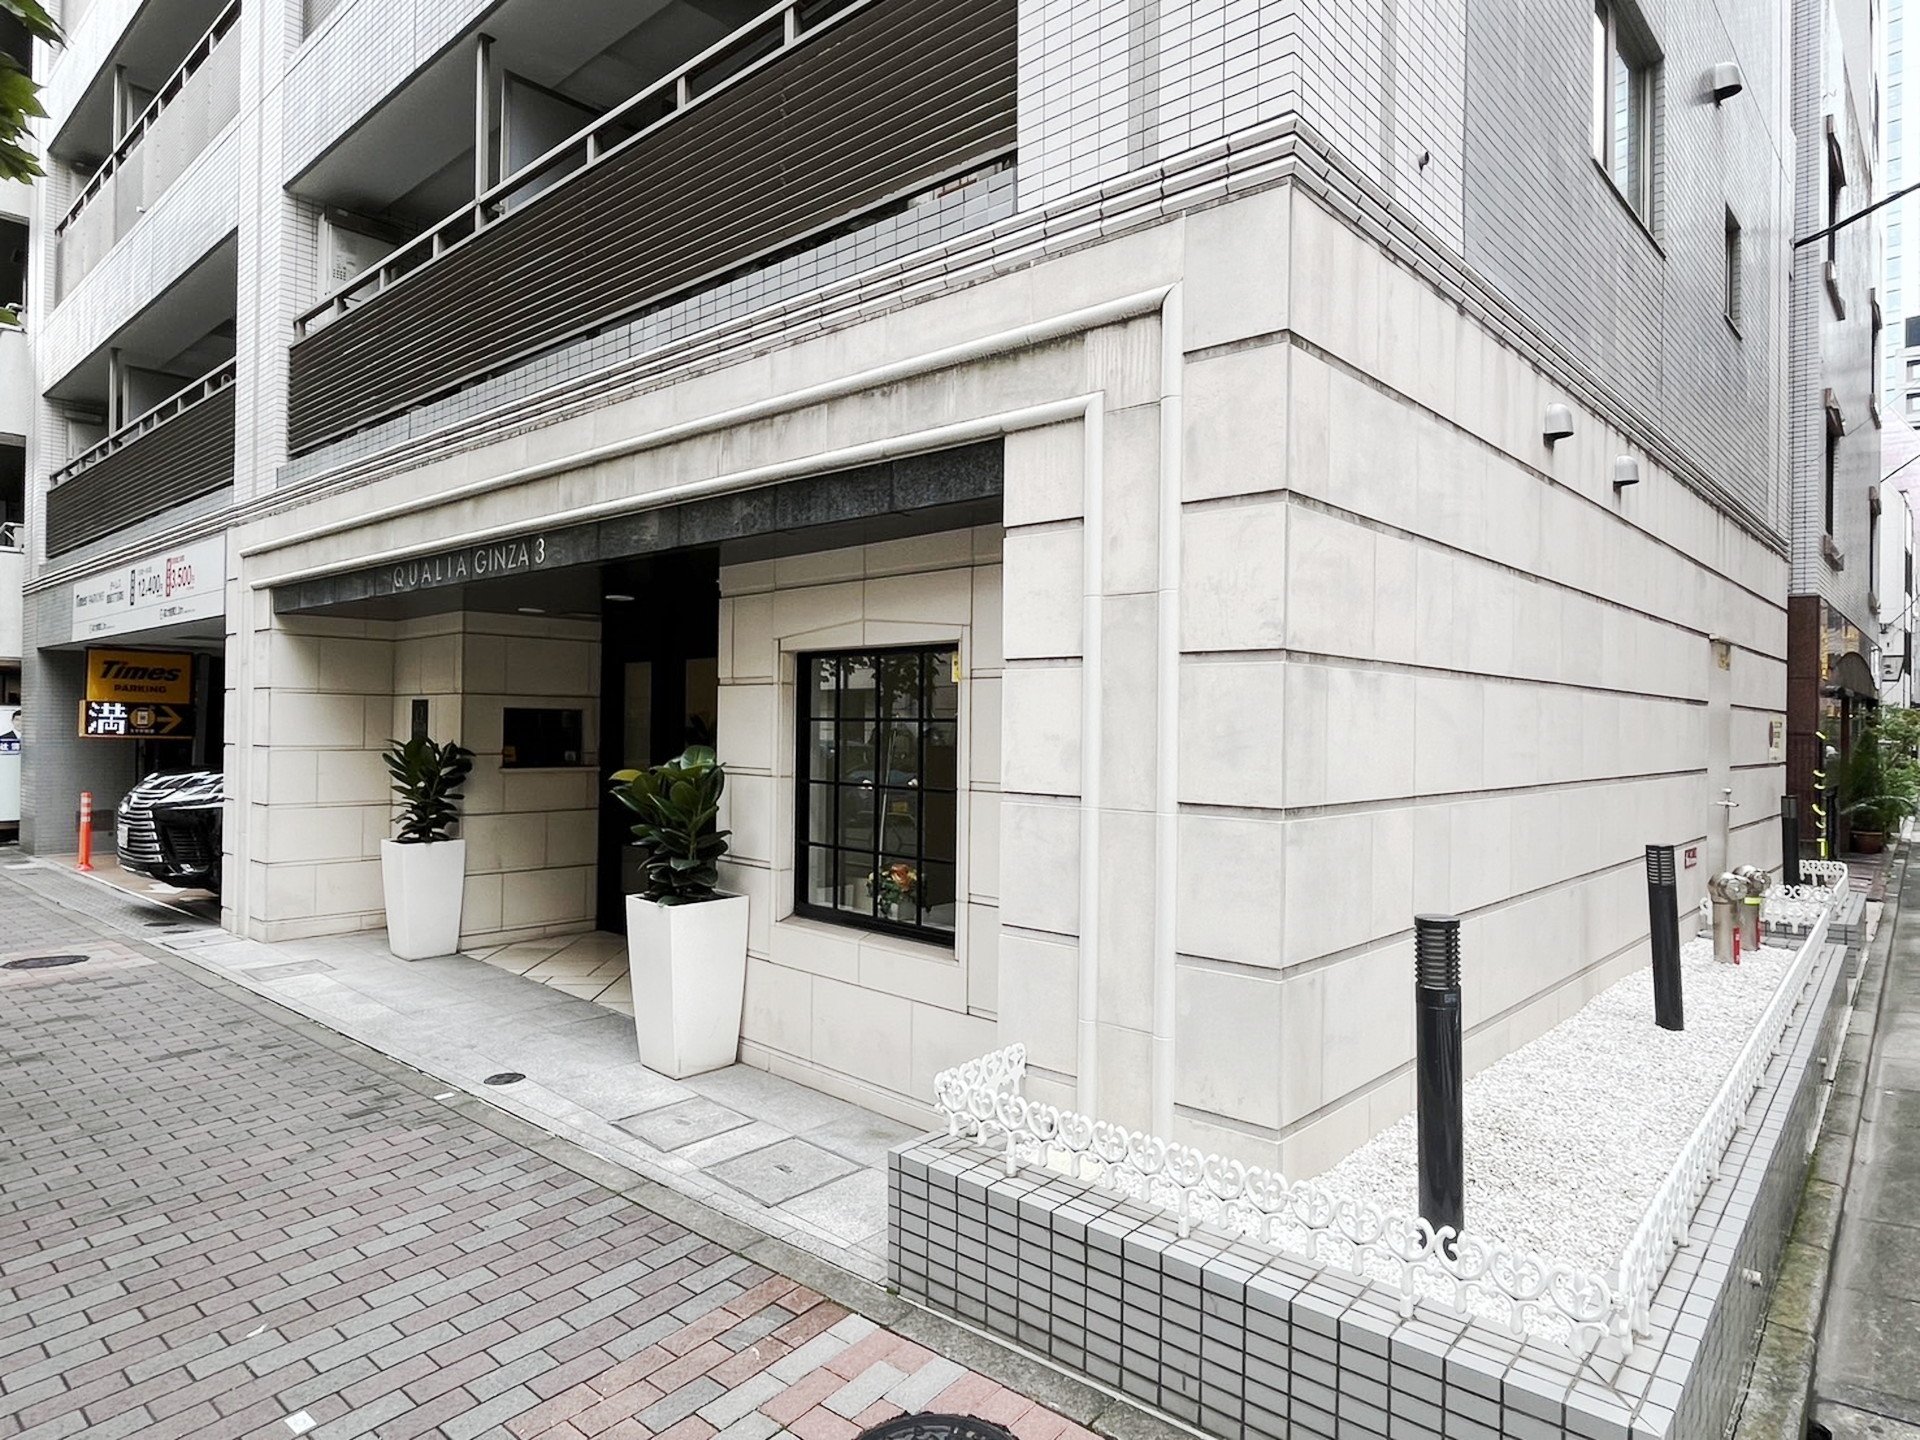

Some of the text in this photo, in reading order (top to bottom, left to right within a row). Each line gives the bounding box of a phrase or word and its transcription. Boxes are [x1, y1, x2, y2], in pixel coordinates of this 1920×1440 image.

[393, 537, 546, 588] QUALIA GINZA 3
[100, 659, 182, 681] Times
[114, 684, 167, 694] PARKING
[88, 701, 128, 735] 満
